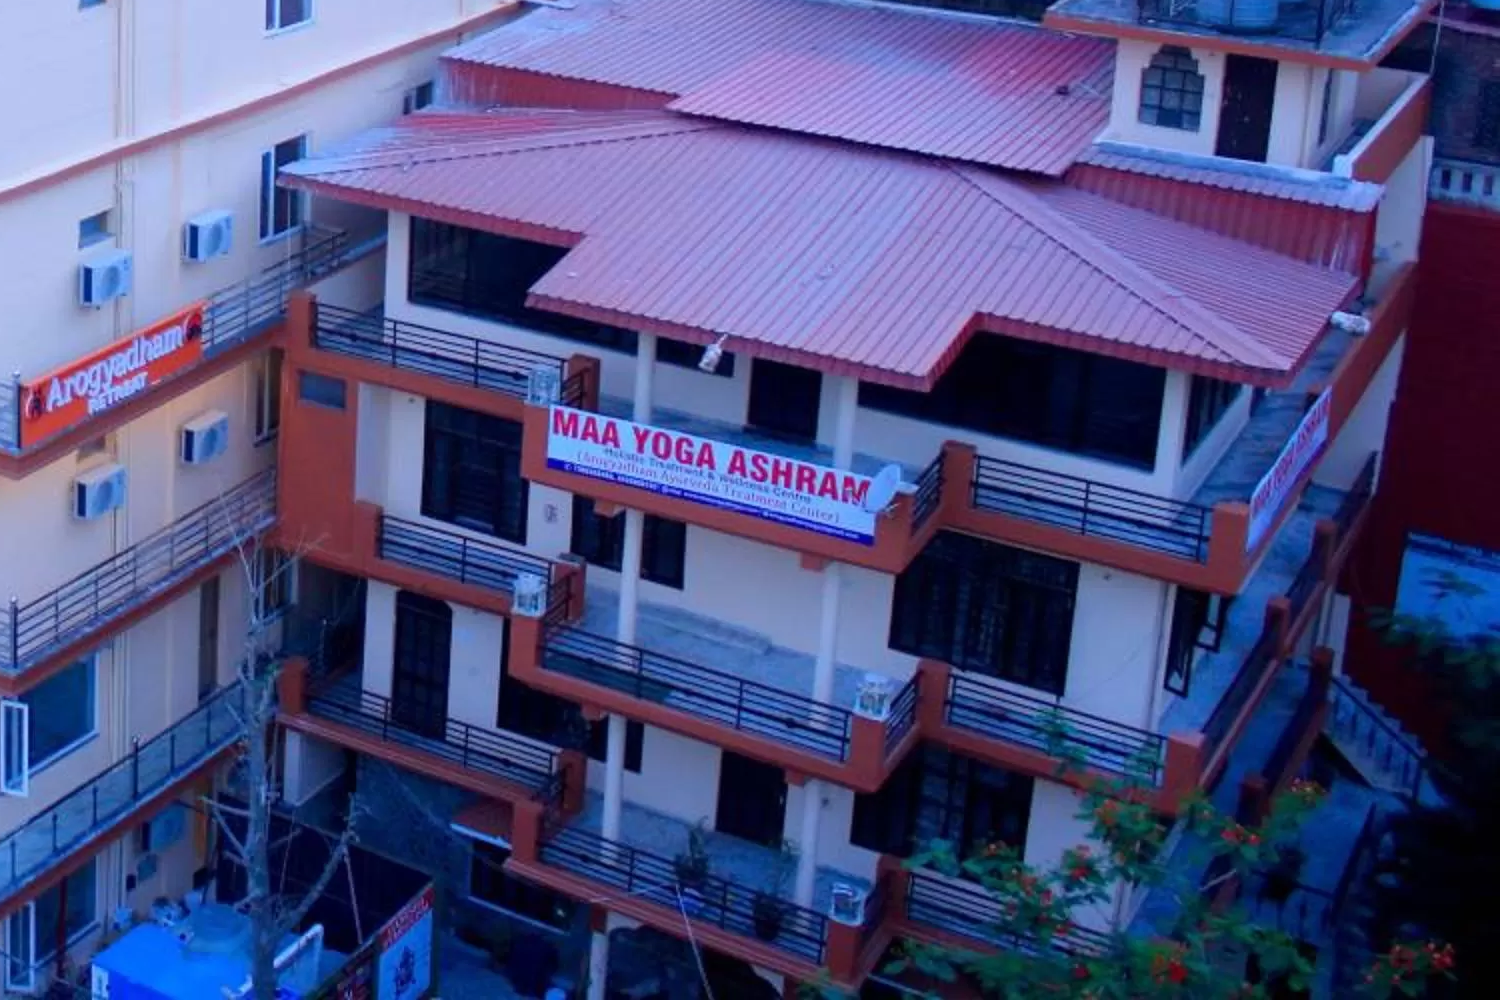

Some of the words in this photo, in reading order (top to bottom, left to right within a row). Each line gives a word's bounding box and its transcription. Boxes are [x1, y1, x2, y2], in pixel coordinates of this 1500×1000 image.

[46, 323, 185, 413] Arogyadham
[553, 407, 621, 449] MAA
[632, 424, 717, 471] YOGA
[727, 448, 871, 508] ASHRAM
